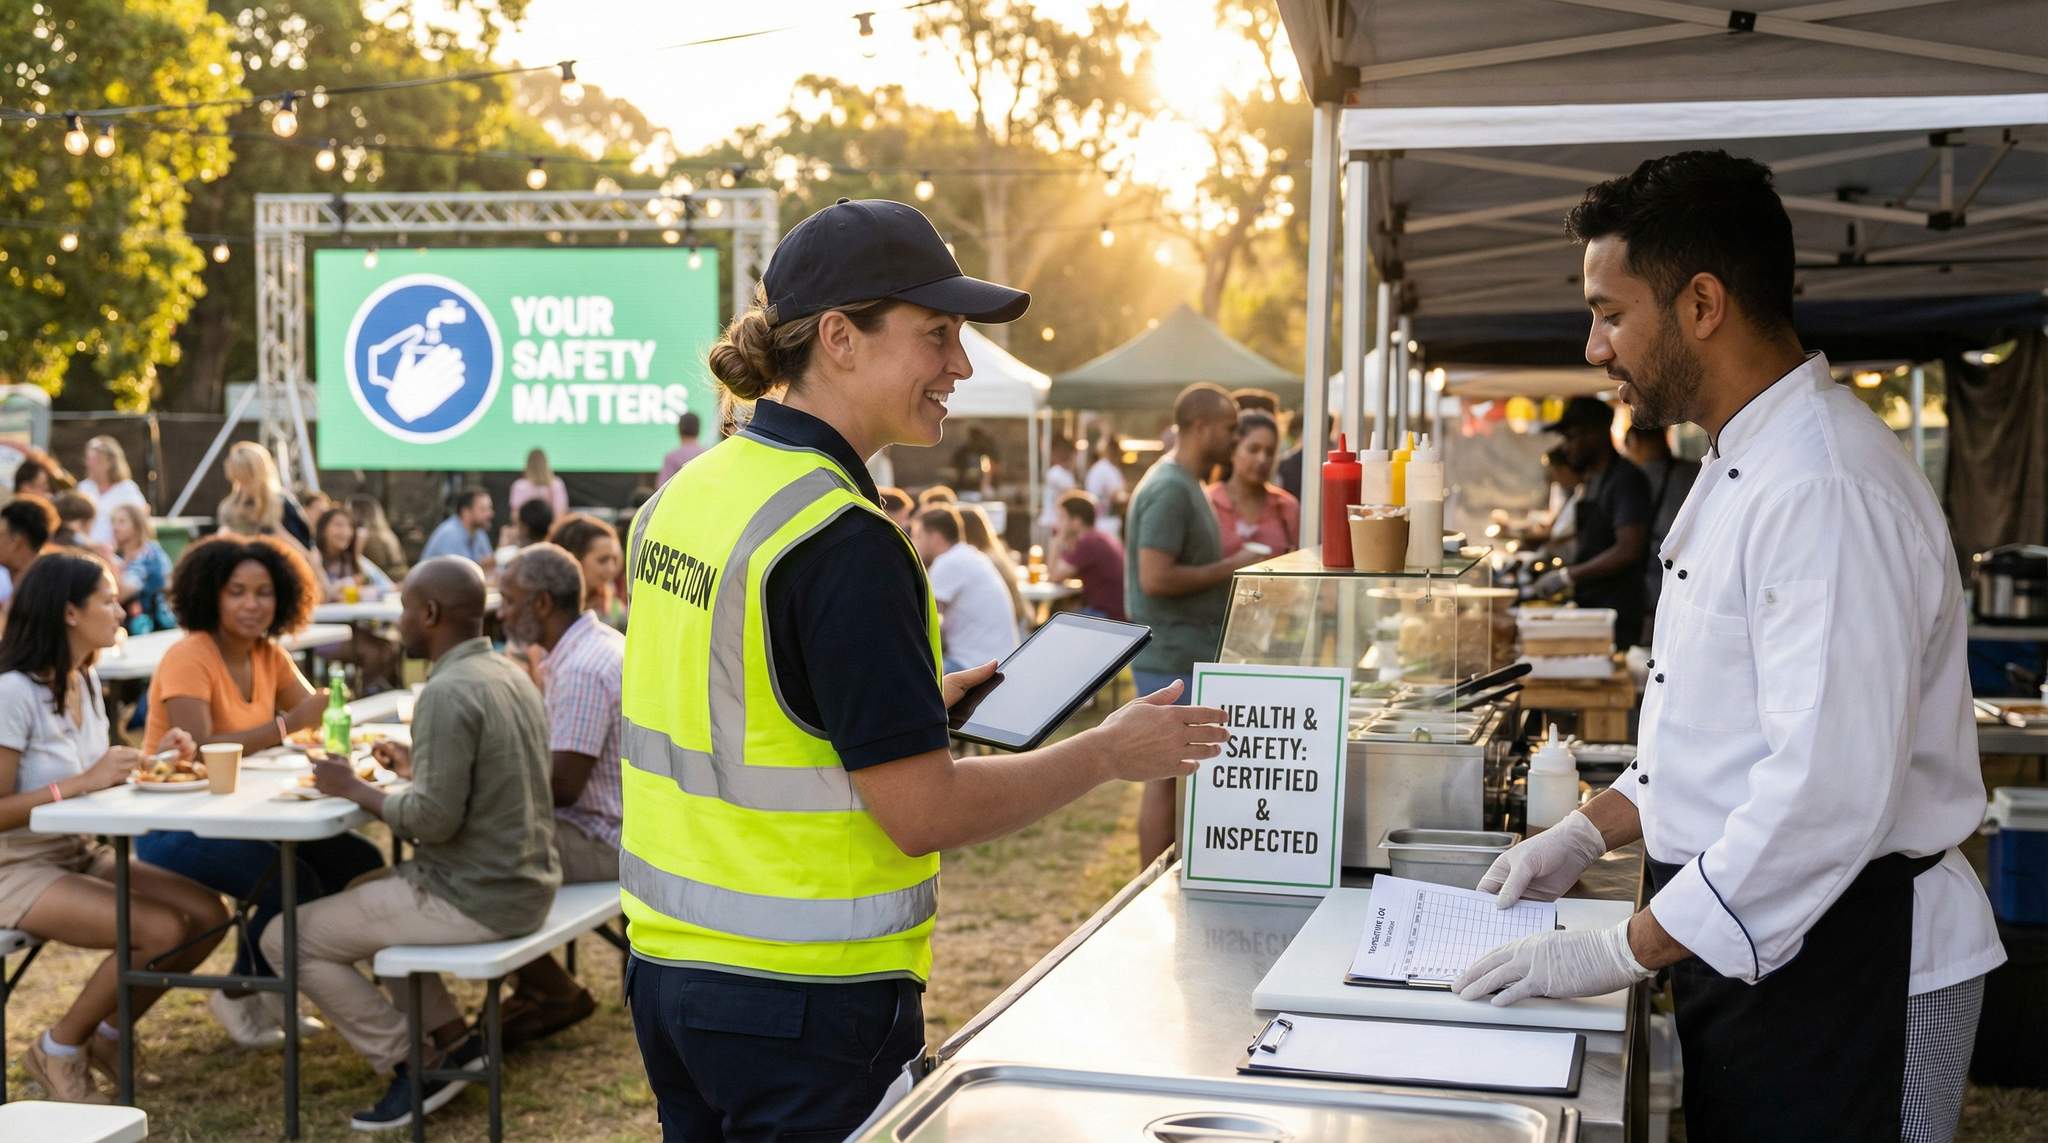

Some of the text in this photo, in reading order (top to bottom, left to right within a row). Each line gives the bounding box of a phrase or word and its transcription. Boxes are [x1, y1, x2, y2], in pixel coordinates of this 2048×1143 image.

[511, 296, 614, 336] YOUR
[512, 339, 656, 380] SAFETY
[512, 383, 689, 425] MATTERS
[1219, 704, 1318, 731] HEALTH &
[1225, 734, 1307, 761] SAFETY:
[1212, 765, 1319, 793] CERTIFIED
[1255, 797, 1270, 821] &
[1205, 826, 1319, 855] INSPECTED
